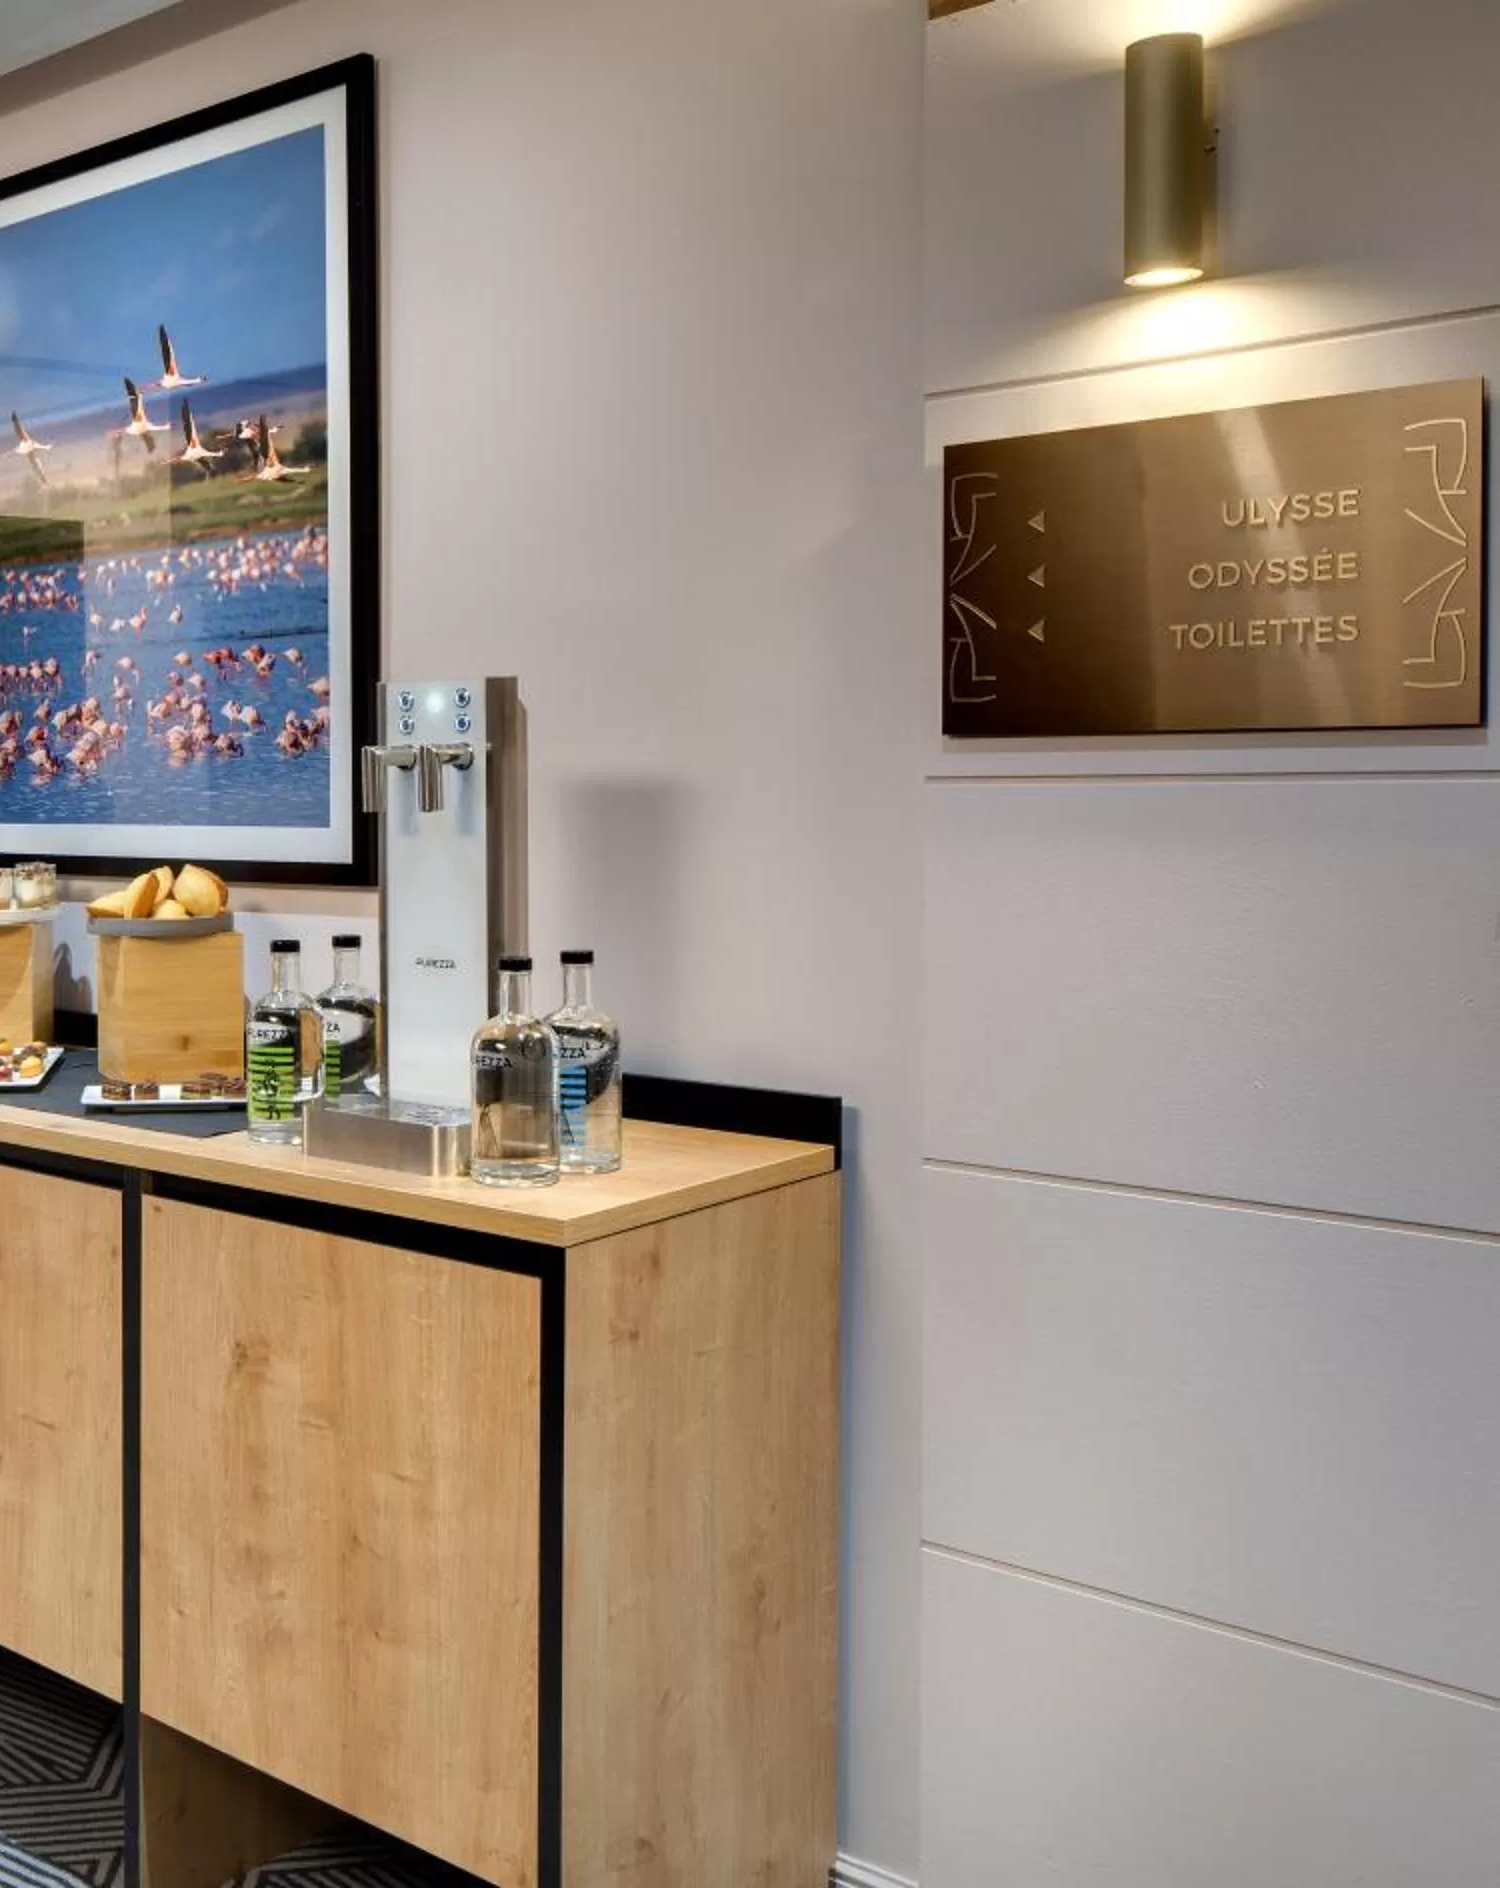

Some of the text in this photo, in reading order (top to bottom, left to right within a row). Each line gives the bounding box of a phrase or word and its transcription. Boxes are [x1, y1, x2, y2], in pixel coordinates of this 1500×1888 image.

[1221, 489, 1360, 528] ULYSSE
[1187, 547, 1360, 590] ODYSSÉE
[1168, 614, 1360, 650] TOILETTES
